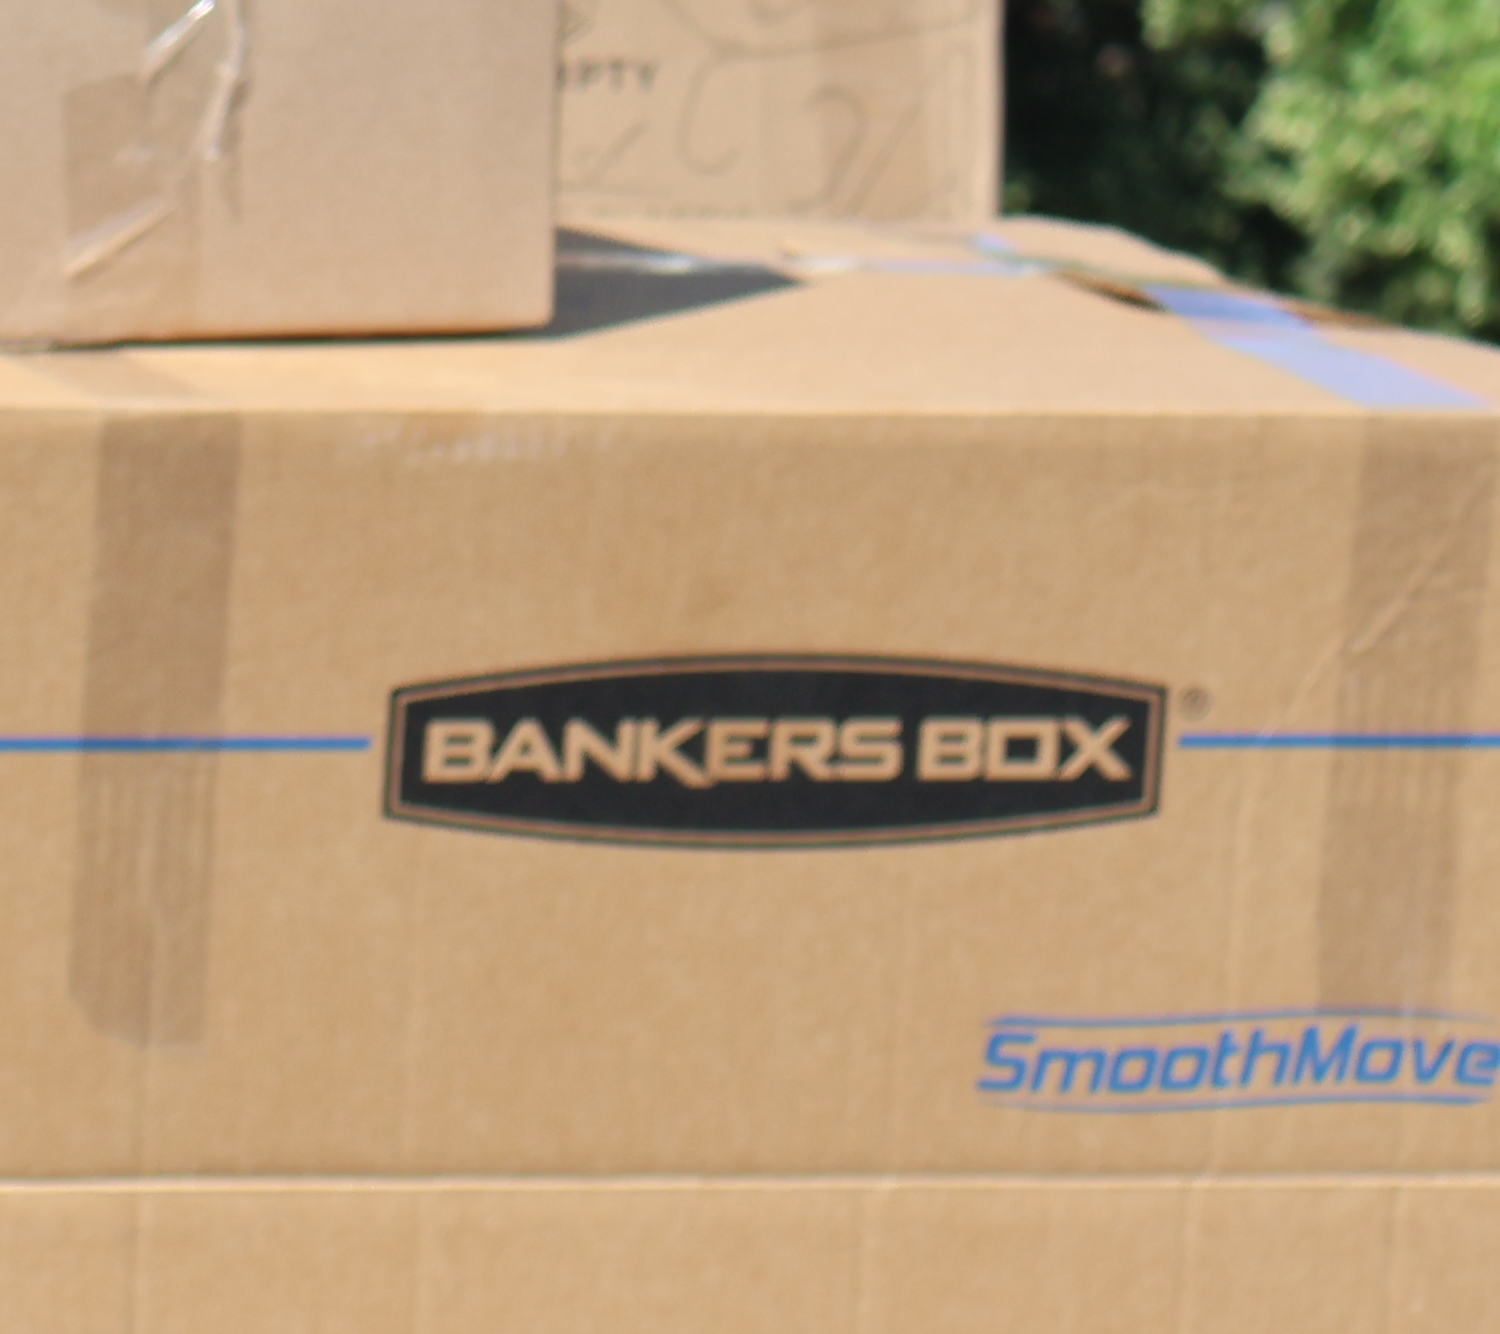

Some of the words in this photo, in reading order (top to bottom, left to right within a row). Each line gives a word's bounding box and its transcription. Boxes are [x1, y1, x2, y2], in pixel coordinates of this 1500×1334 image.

[423, 717, 901, 788] BANKERS
[916, 717, 1132, 783] BOX
[976, 1023, 1500, 1095] SmoothMove
